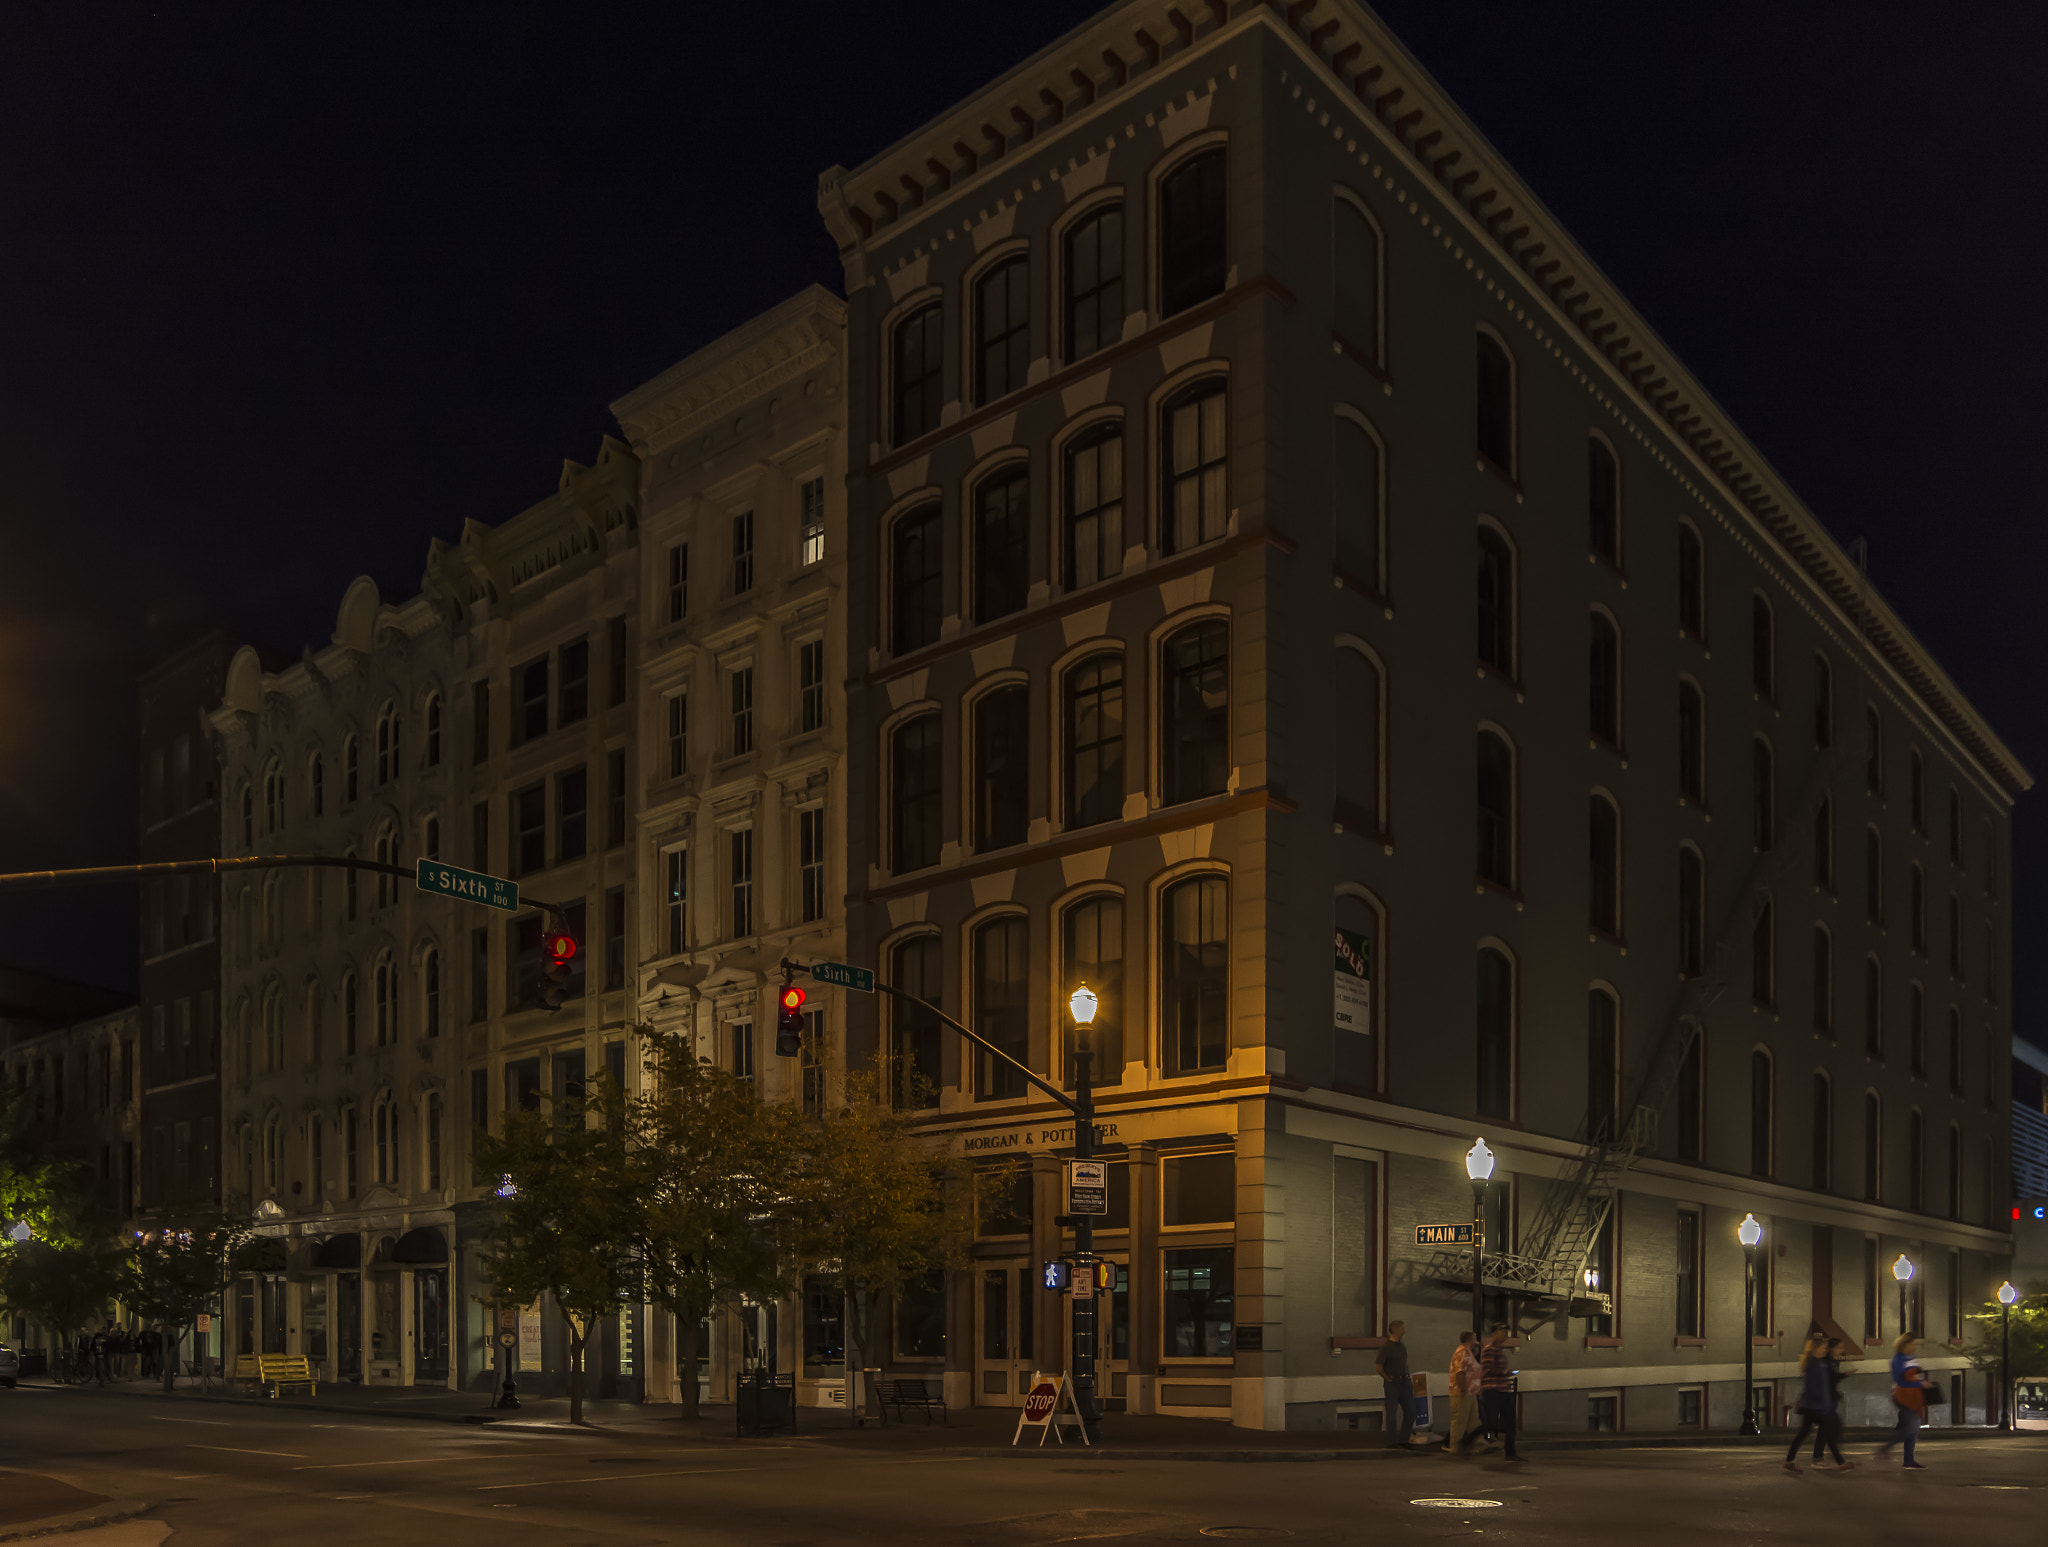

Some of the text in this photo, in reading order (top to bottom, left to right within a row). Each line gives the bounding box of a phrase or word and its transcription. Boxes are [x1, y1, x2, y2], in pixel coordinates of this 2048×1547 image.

[429, 871, 504, 899] S Sixth ST
[493, 893, 508, 906] 100
[1335, 932, 1364, 977] SOLD
[824, 965, 850, 983] Sixth
[964, 1133, 1019, 1150] MORGAN
[1026, 1132, 1034, 1145] &
[1426, 1227, 1456, 1243] MAIN
[1026, 1394, 1055, 1411] STOP
